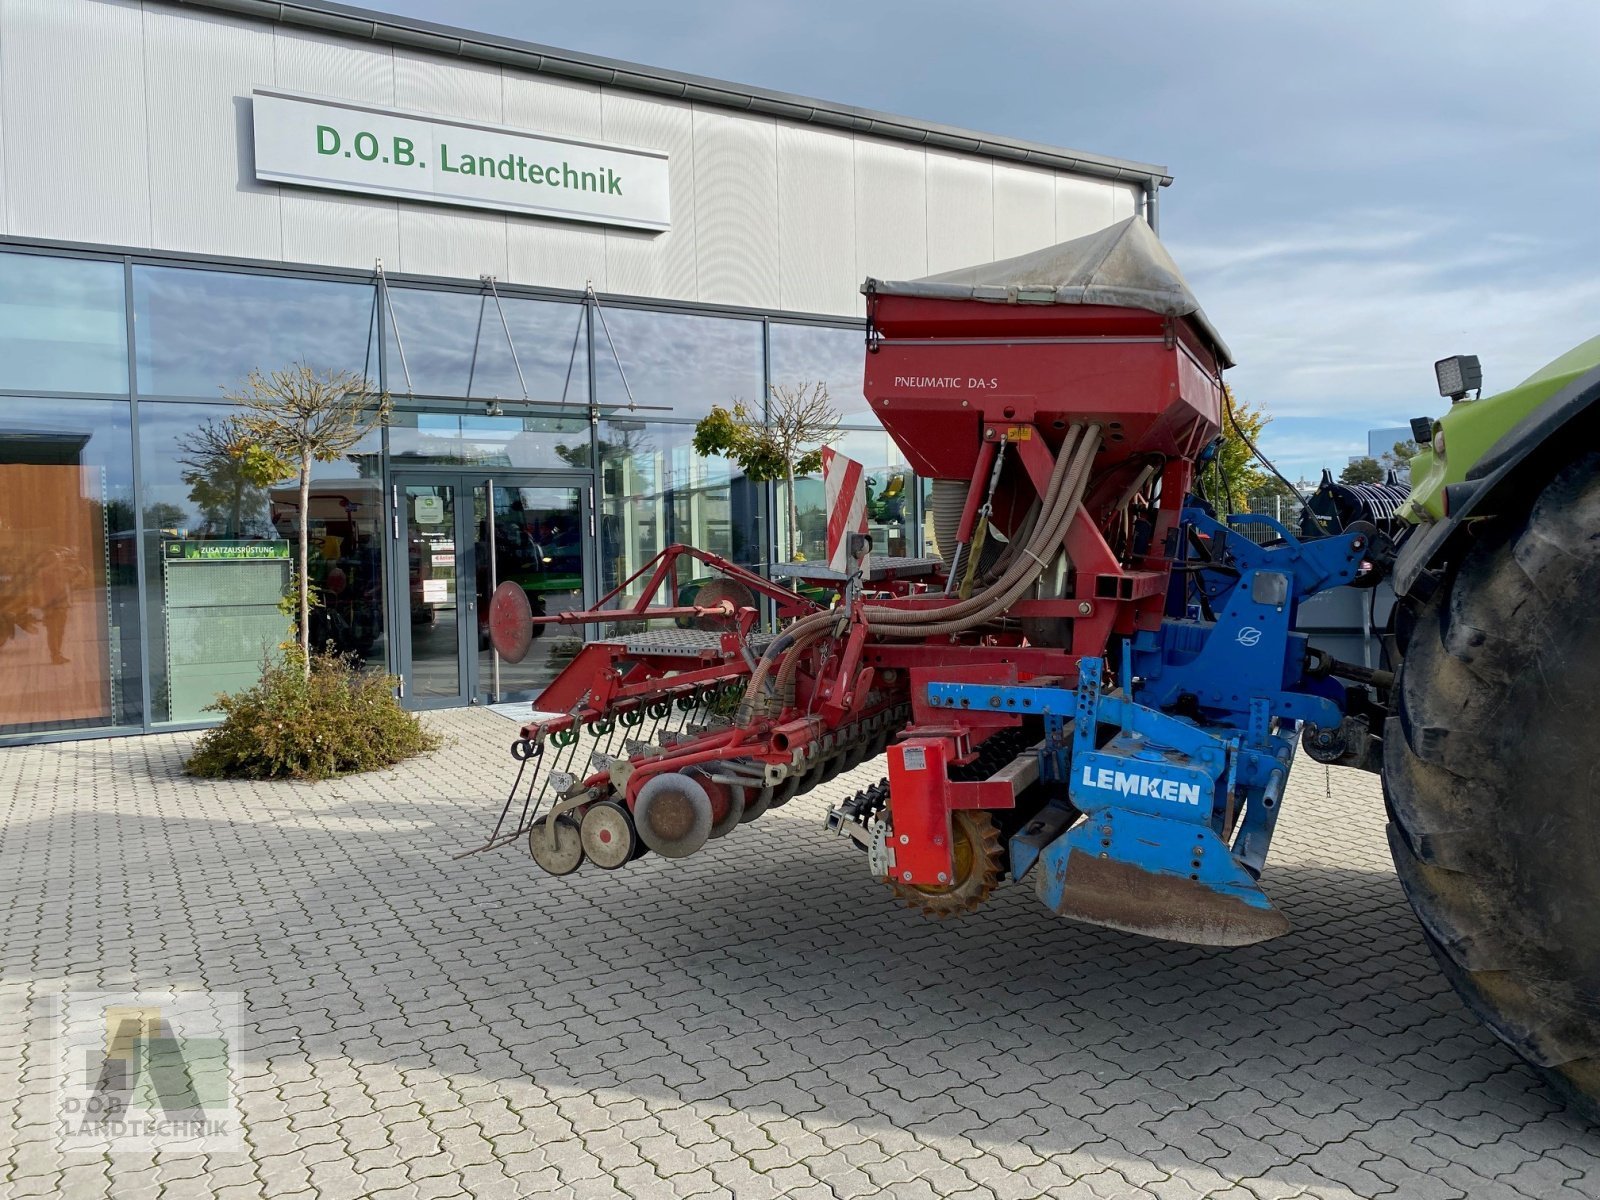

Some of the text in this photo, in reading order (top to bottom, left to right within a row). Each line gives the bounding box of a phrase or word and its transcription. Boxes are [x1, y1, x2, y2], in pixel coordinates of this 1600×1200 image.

[316, 124, 623, 196] D.O.B. Landtechnik
[894, 376, 998, 389] PNEUMATIC DA-S
[200, 545, 275, 555] ZUSATZAUSRÜSTUNG
[1082, 765, 1201, 806] LEMKEN
